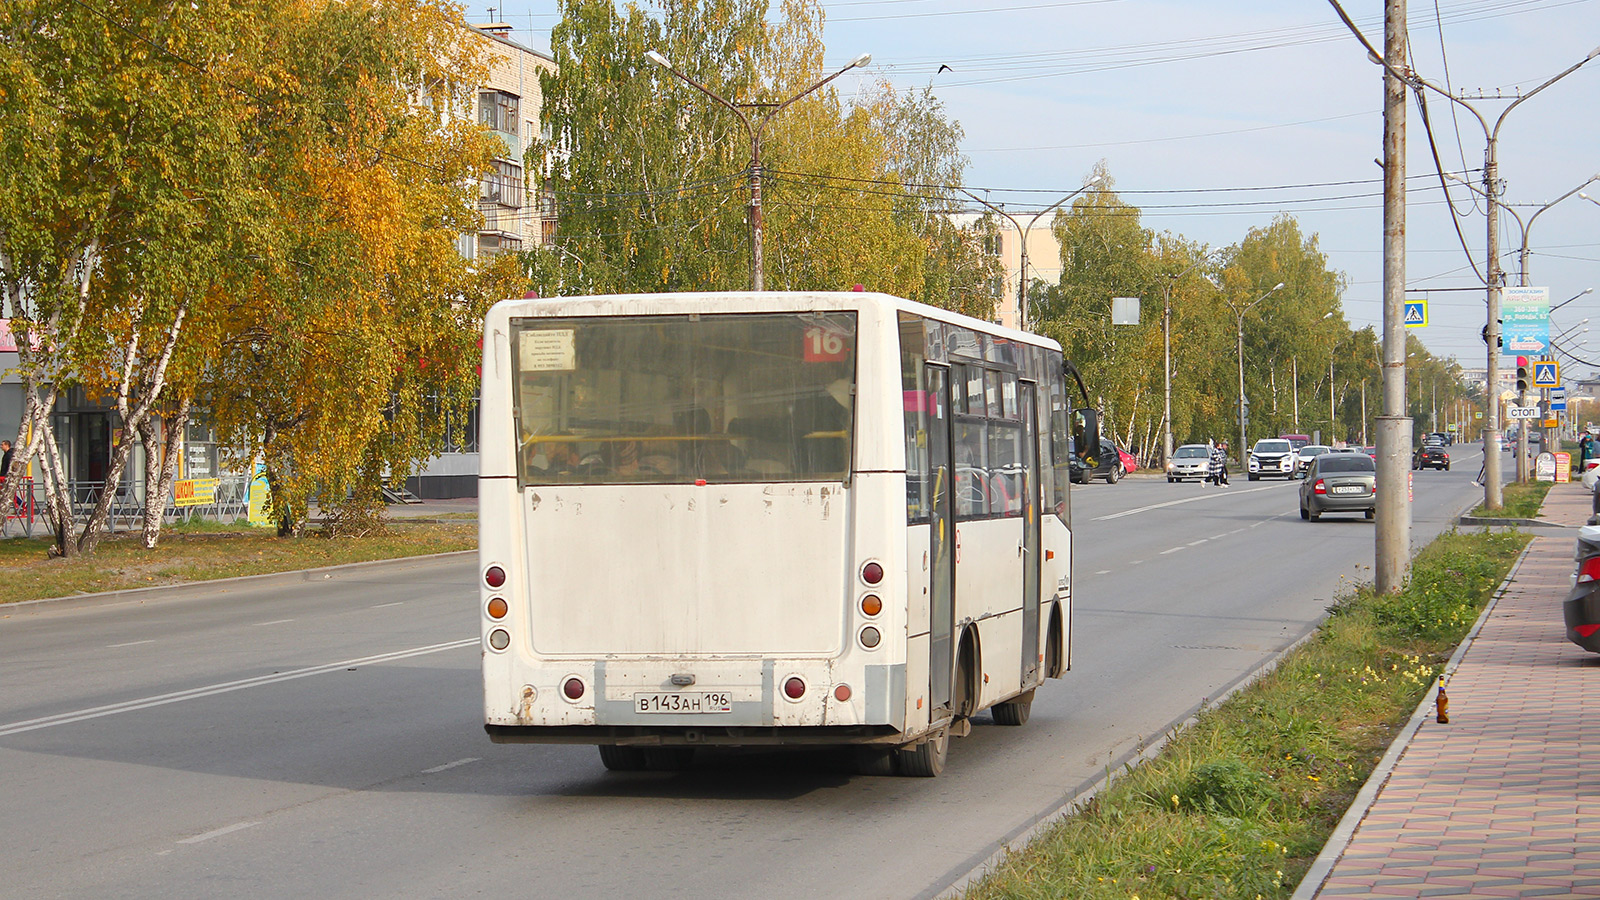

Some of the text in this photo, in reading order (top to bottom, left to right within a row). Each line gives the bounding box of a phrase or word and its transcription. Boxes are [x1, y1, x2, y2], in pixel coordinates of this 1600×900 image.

[806, 327, 843, 355] 16
[1511, 408, 1535, 417] СТОП
[640, 694, 728, 711] В143АН 196
